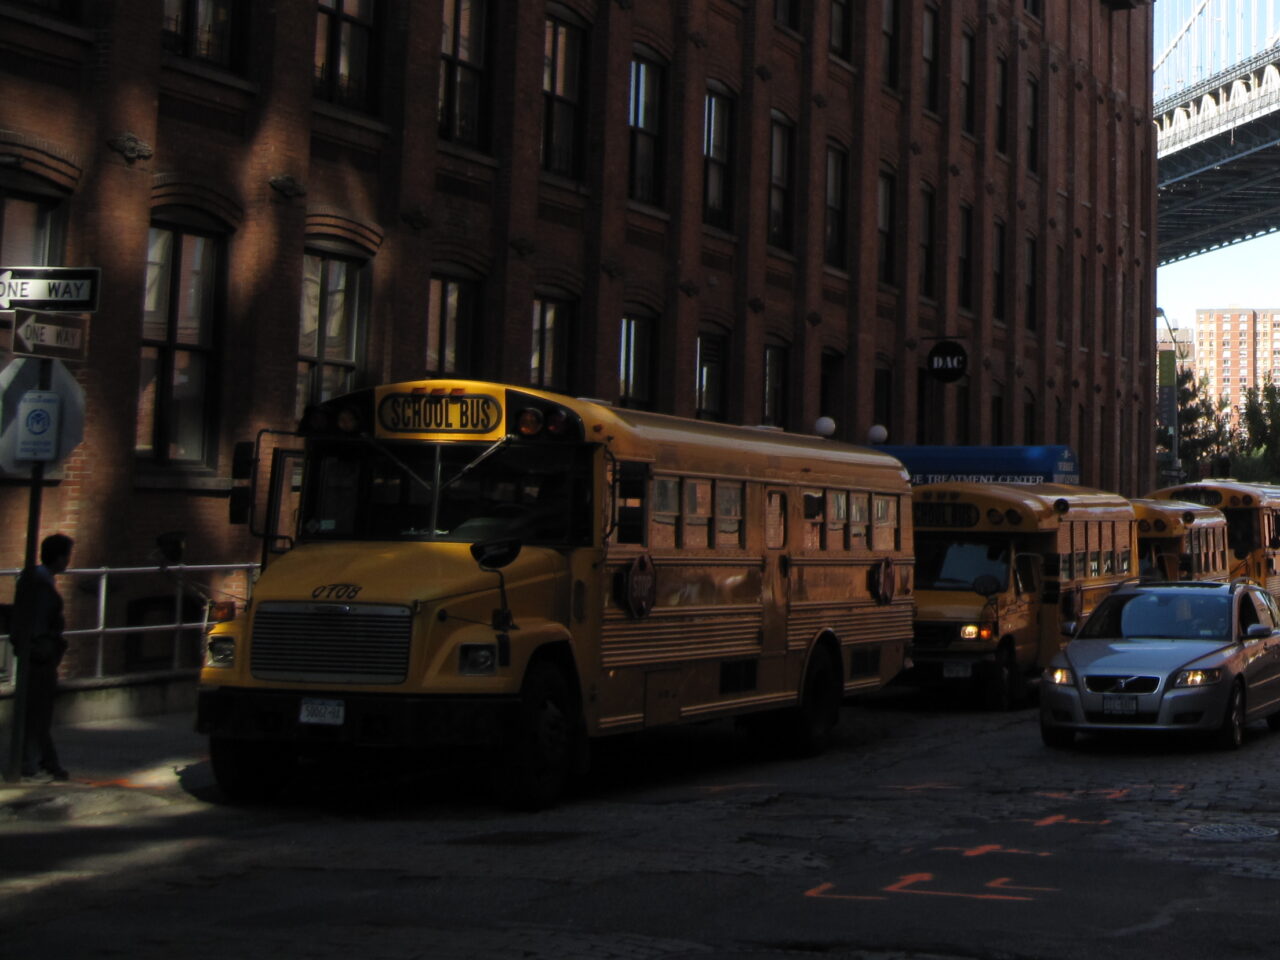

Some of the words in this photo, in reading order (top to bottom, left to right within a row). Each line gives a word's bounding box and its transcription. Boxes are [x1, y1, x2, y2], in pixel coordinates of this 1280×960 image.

[48, 282, 84, 298] WAY
[25, 324, 46, 342] ONE
[56, 327, 80, 346] WAY
[933, 355, 963, 369] DAC
[391, 398, 453, 428] SCHOOL
[459, 399, 491, 428] BUS
[926, 474, 993, 484] TREATMENT
[997, 475, 1045, 485] CENTER
